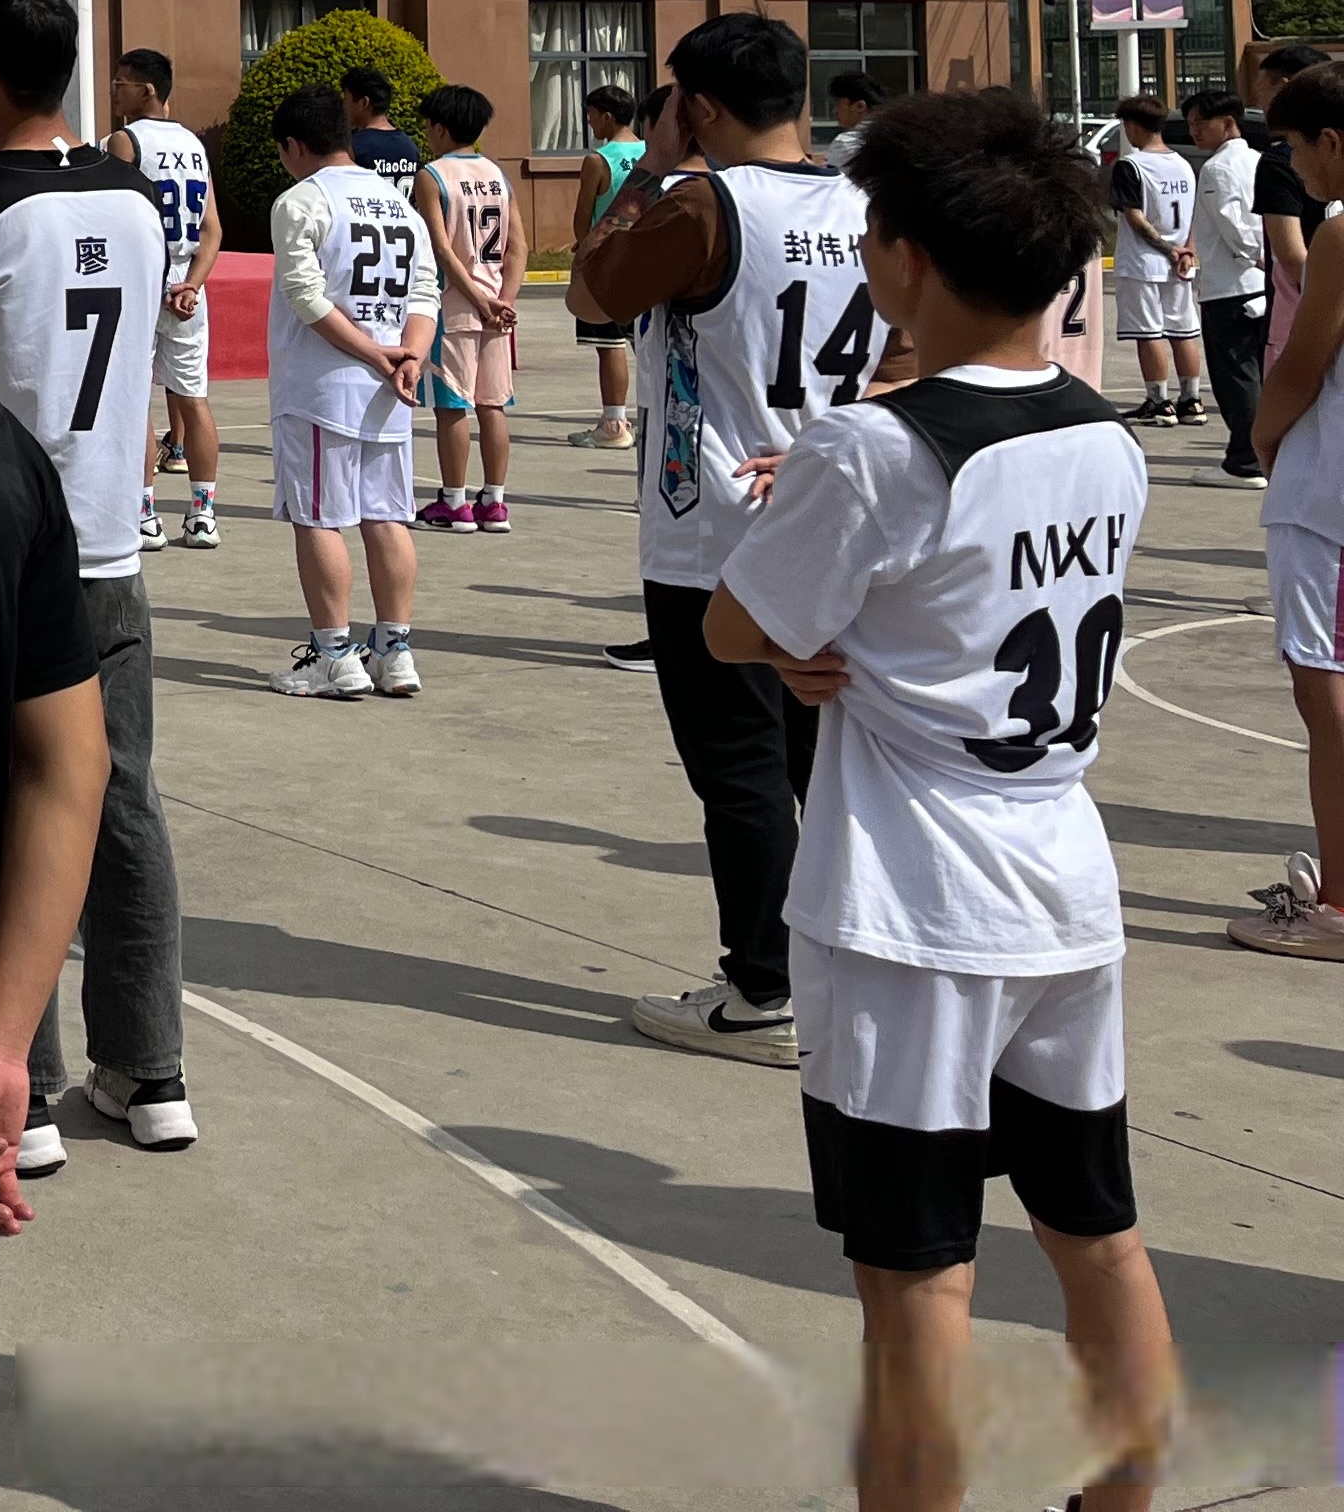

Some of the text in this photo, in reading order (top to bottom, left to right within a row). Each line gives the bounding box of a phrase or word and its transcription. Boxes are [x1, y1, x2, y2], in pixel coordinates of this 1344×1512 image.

[346, 196, 408, 219] 研学班
[467, 205, 502, 264] 12
[1170, 200, 1181, 230] 1
[75, 236, 110, 276] 廖
[349, 222, 415, 298] 23
[65, 286, 123, 432] 7
[766, 279, 875, 409] 14
